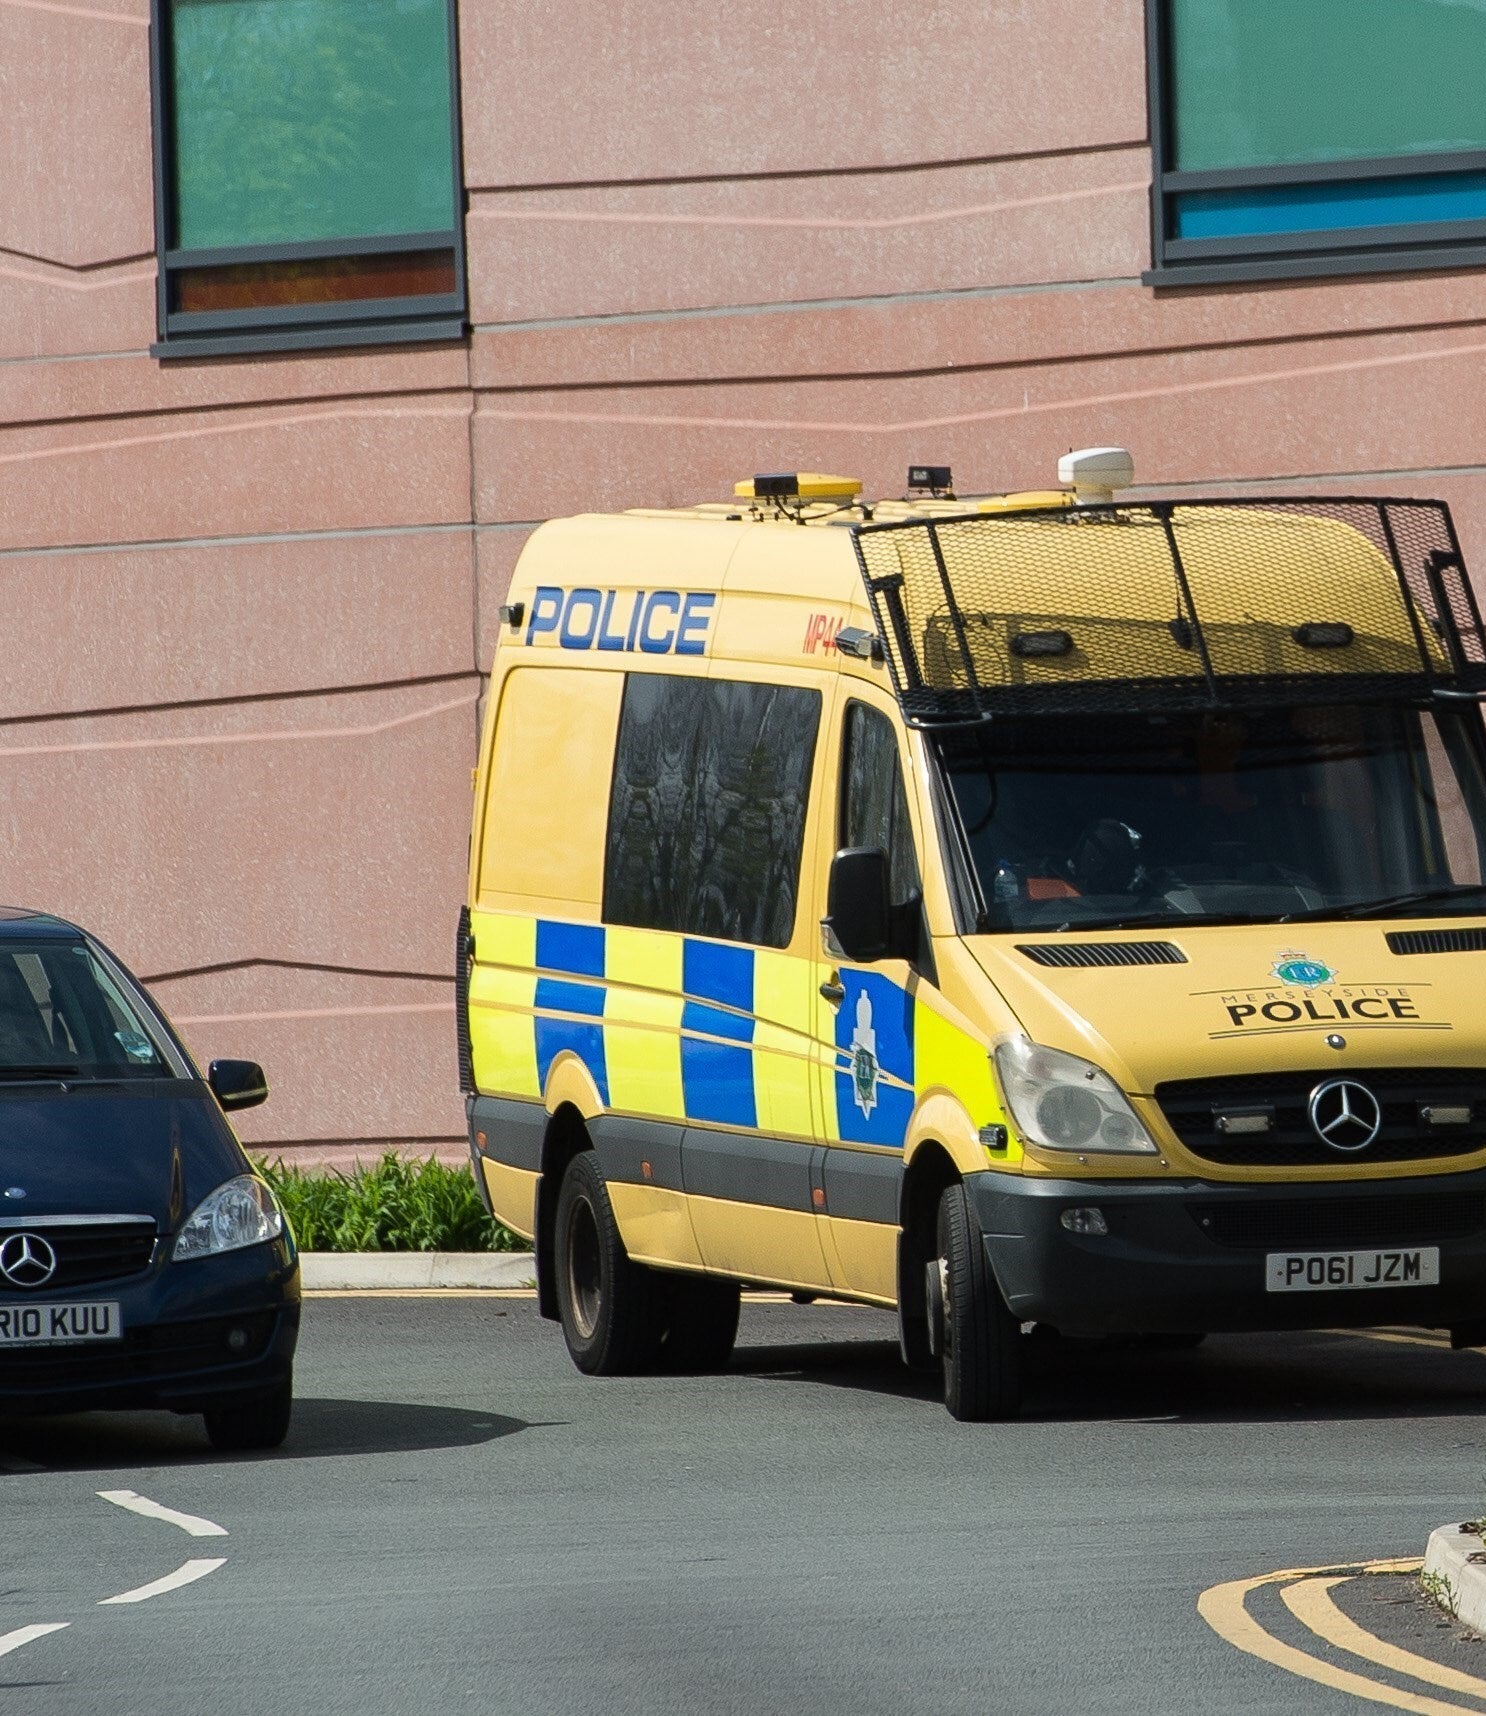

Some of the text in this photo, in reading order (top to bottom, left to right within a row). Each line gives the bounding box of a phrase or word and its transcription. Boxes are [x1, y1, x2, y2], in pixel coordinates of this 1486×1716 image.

[526, 586, 716, 655] POLICE
[1220, 988, 1410, 1004] MERSEYSIDE
[1226, 998, 1420, 1026] POLICE
[1286, 1252, 1421, 1286] PO61 JZM
[50, 1305, 110, 1336] KUU
